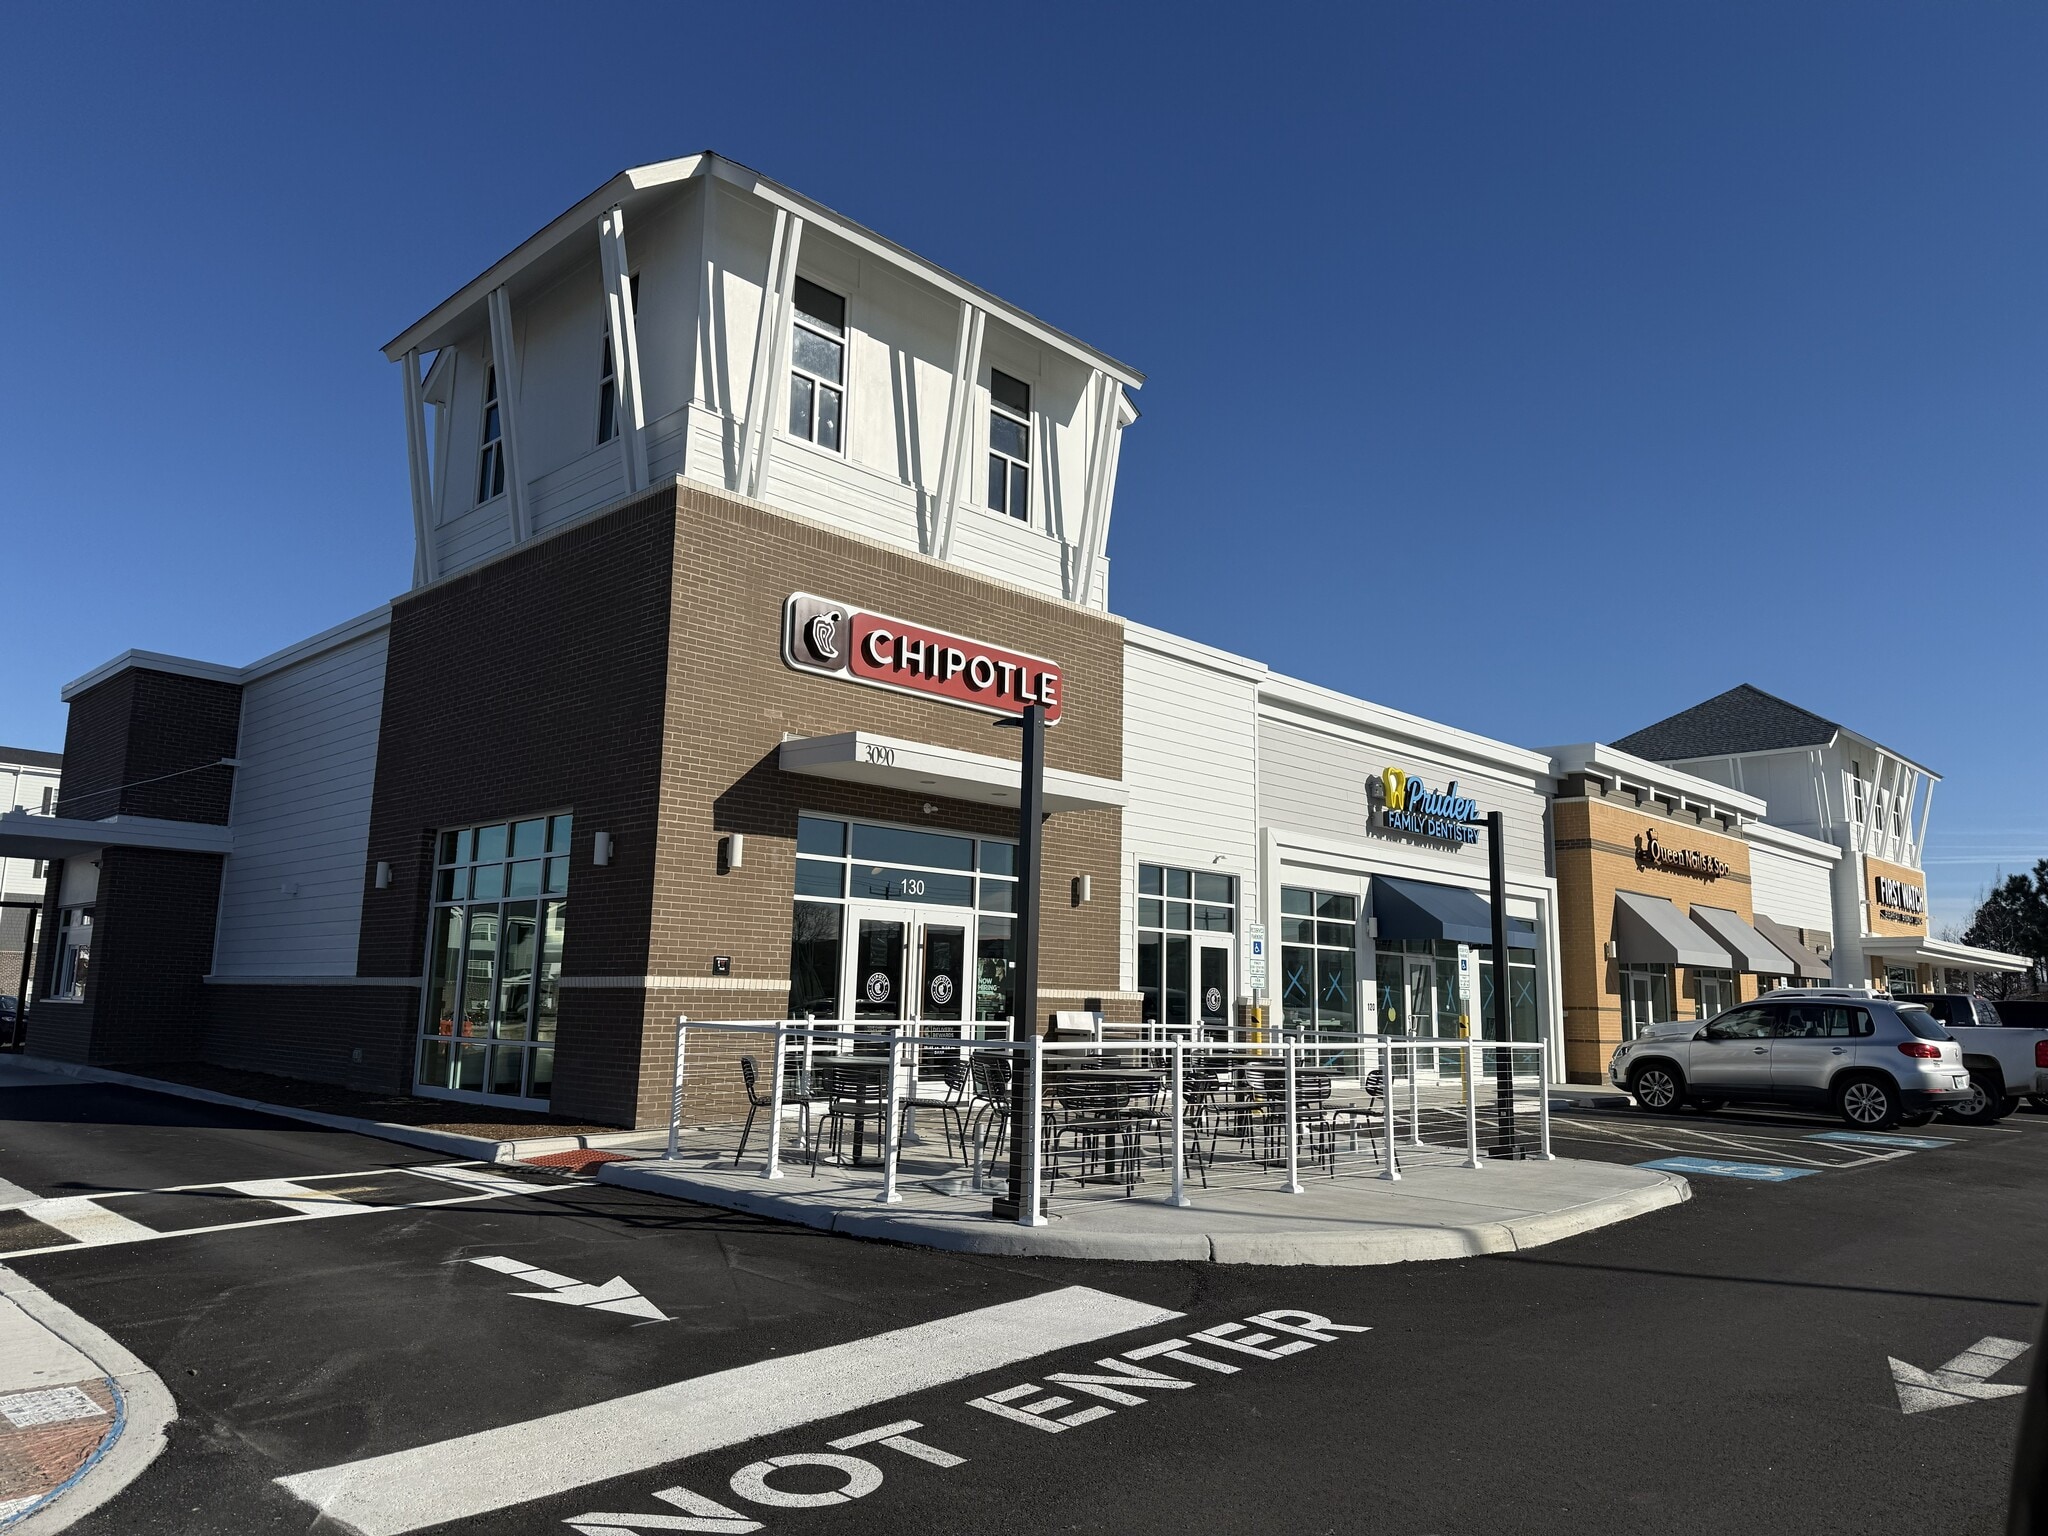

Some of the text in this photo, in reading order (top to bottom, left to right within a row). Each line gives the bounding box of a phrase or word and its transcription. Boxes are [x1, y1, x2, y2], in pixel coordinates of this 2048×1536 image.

[867, 630, 1058, 705] CHIPOTLE
[865, 745, 895, 767] 3090
[1407, 776, 1480, 821] Pruden
[1388, 811, 1480, 844] FAMILY DENTISTRY
[1651, 840, 1730, 878] Queen Nails & Spa
[901, 878, 925, 896] 130
[1880, 876, 1923, 912] FIRST WATCH
[561, 1309, 1373, 1536] NOT ENTER
